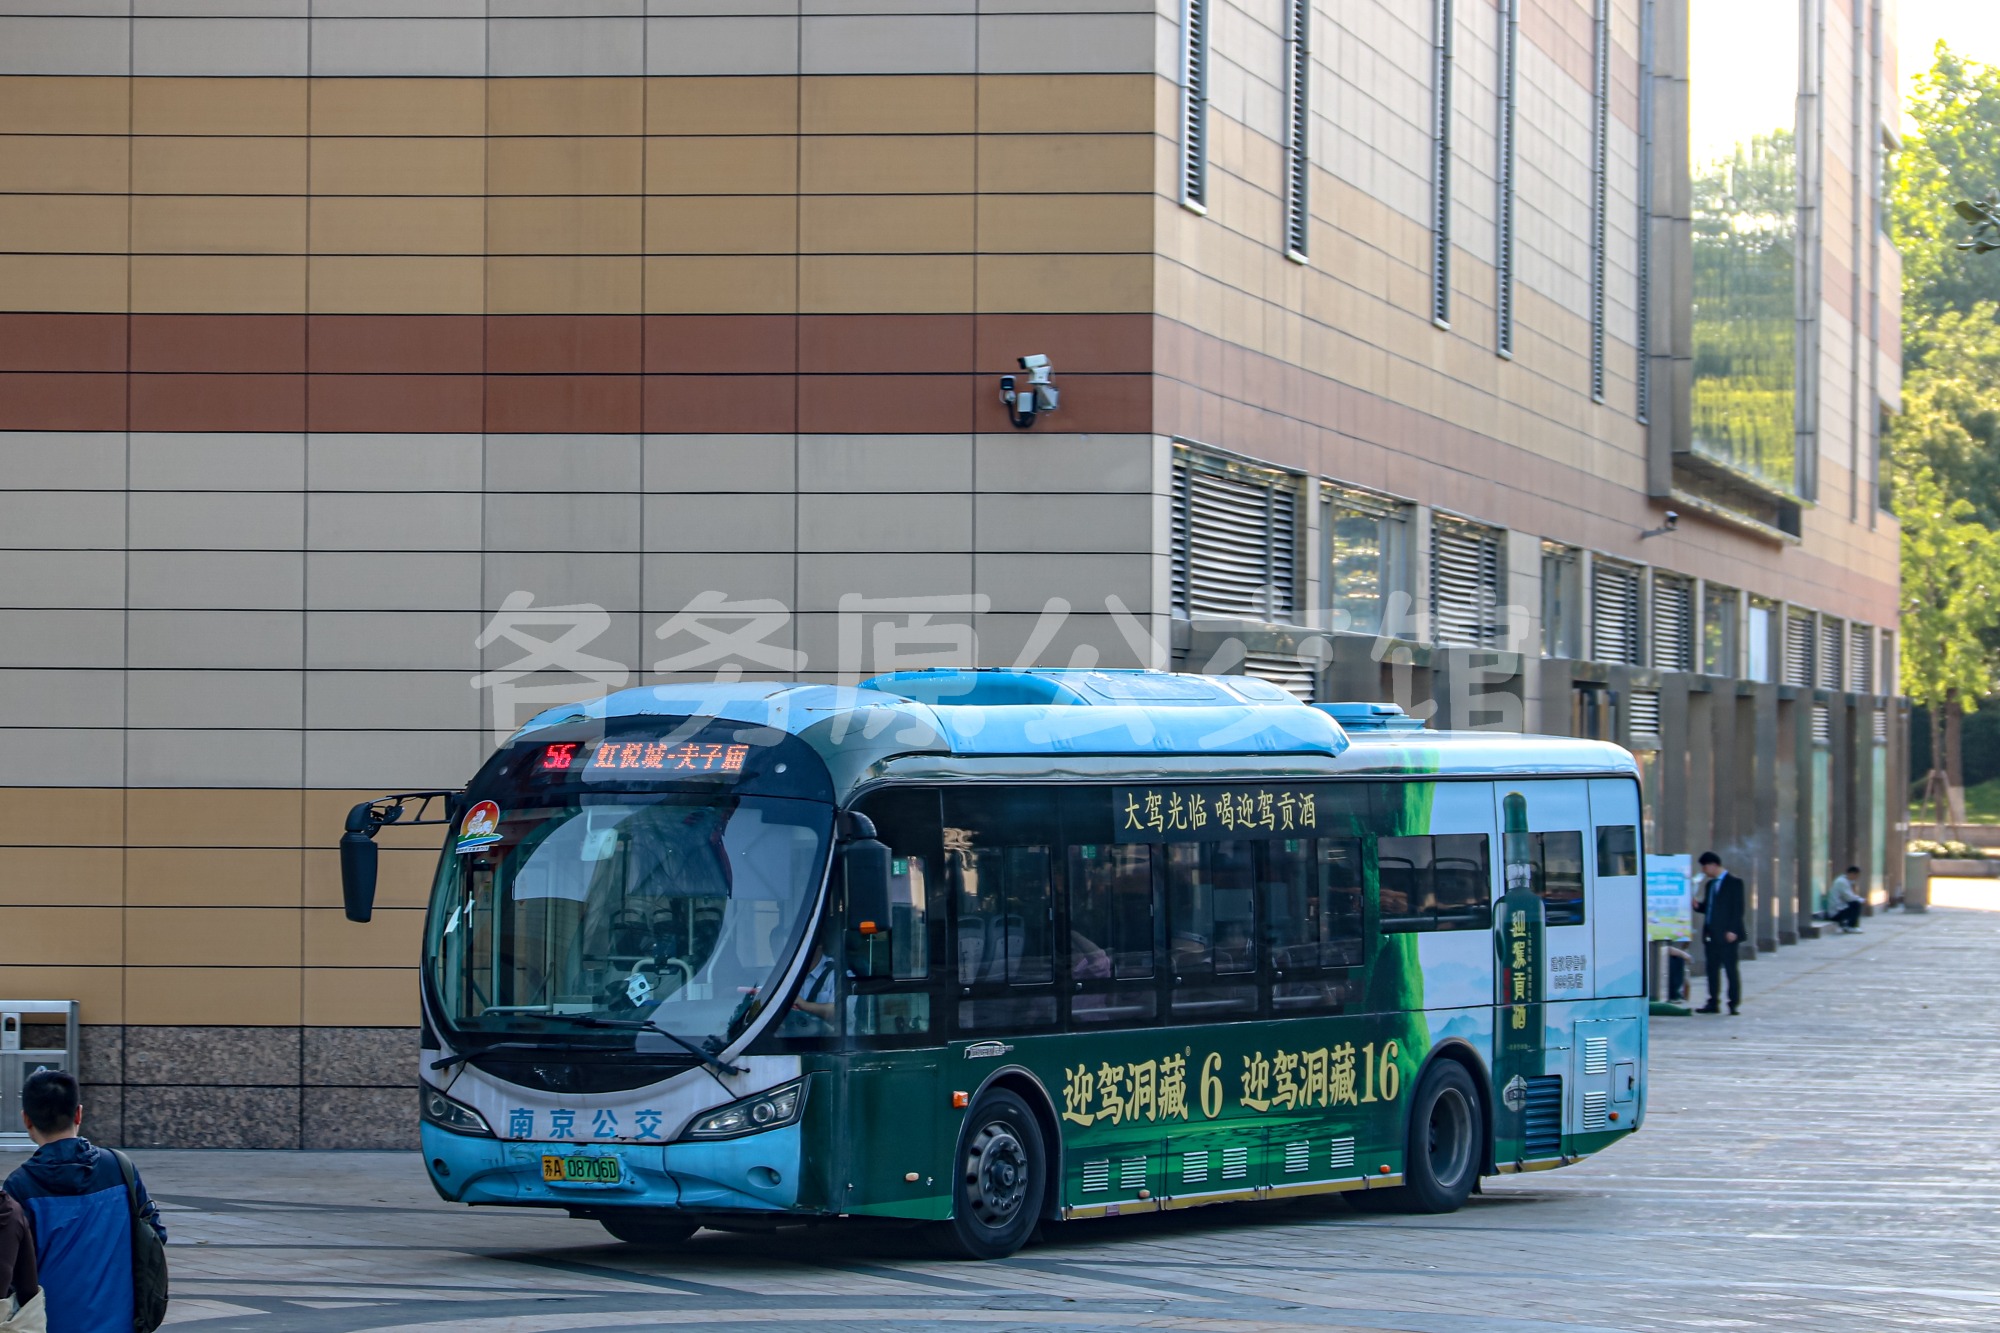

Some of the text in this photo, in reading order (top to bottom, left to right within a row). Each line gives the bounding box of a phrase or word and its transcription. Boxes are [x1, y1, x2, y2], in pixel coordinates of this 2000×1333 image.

[543, 744, 576, 769] 56
[1124, 790, 1316, 833] 大驾光临 喝迎驾贡酒
[1062, 1052, 1189, 1127] 迎驾洞藏
[1201, 1051, 1223, 1119] 6
[509, 1107, 663, 1140] 南京公交
